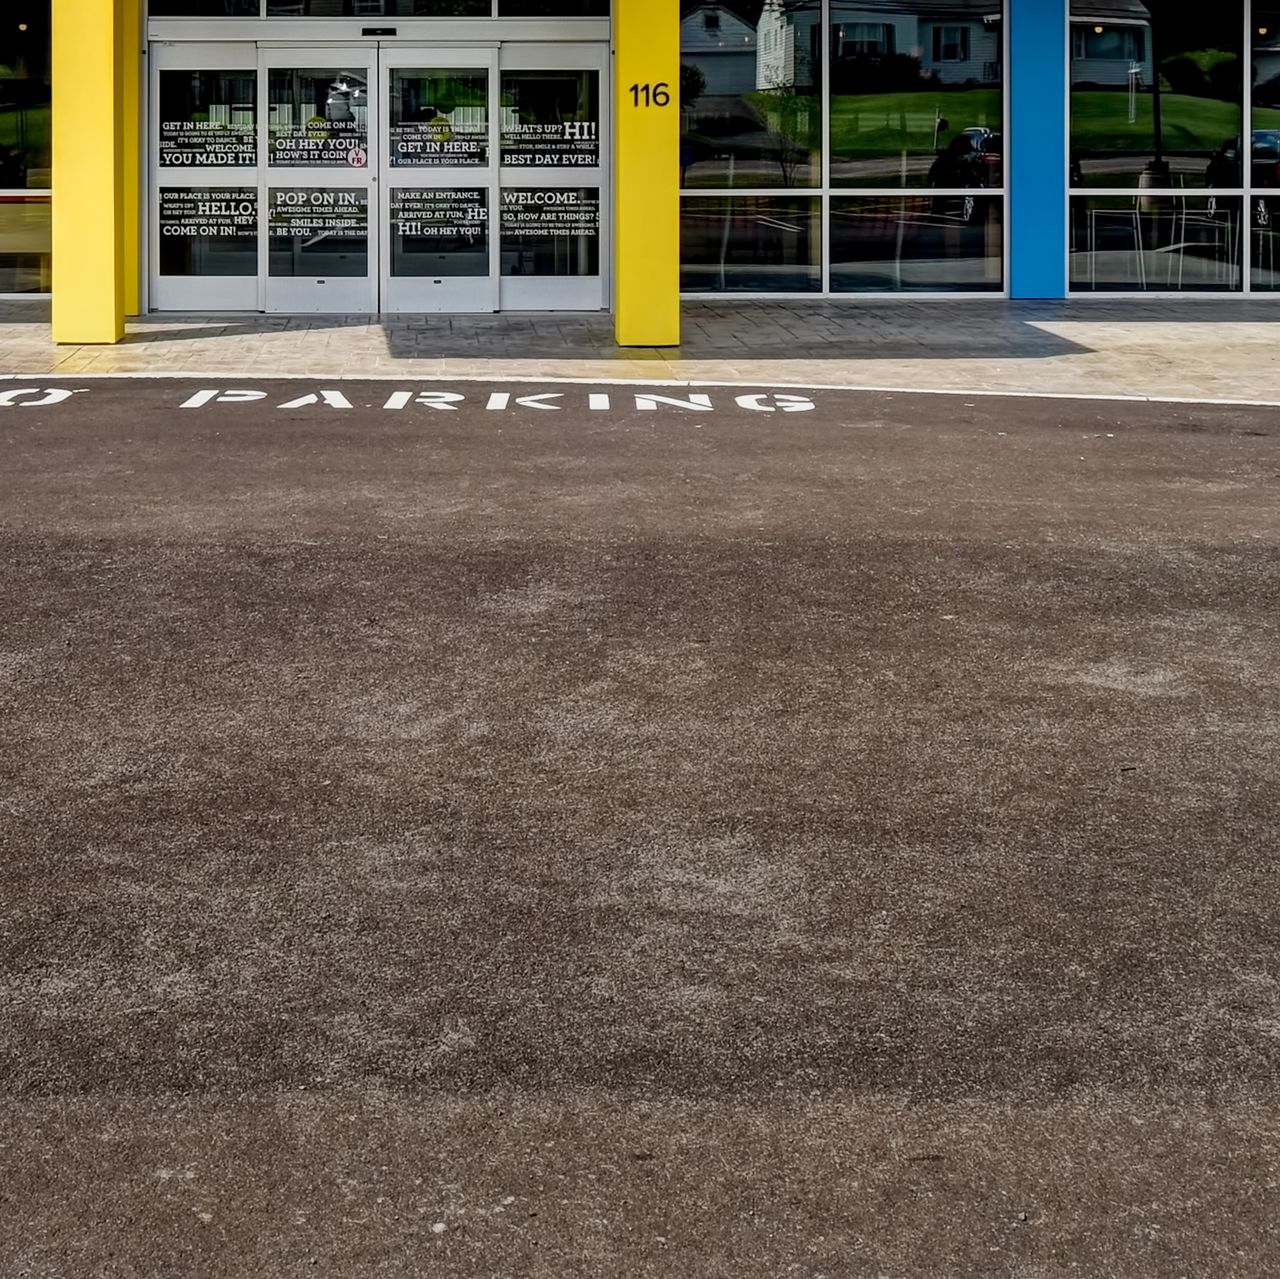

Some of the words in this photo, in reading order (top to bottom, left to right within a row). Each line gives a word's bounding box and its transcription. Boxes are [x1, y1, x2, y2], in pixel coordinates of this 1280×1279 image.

[630, 82, 670, 107] 116
[162, 122, 181, 130] GET
[182, 122, 194, 130] IN
[504, 124, 542, 132] WHAT'S
[544, 124, 562, 132] UP?
[564, 122, 596, 140] HI!
[206, 144, 256, 152] WELCOME.
[276, 139, 297, 149] OH
[298, 139, 326, 149] HEY
[328, 139, 358, 149] YOU!
[398, 142, 424, 152] GET
[426, 142, 440, 152] IN
[444, 142, 480, 152] HERE.
[163, 153, 192, 164] YOU
[195, 153, 235, 164] MADE
[238, 153, 256, 164] IT!
[276, 151, 308, 159] HOW'S
[310, 151, 320, 159] IT
[504, 155, 532, 164] BEST
[535, 155, 560, 164] DAY
[562, 155, 596, 164] EVER!
[276, 193, 307, 204] POP
[310, 193, 335, 204] ON
[338, 193, 359, 204] IN.
[503, 193, 580, 204] WELCOME.
[198, 202, 256, 215] HELLO.
[163, 226, 198, 235] COME
[200, 226, 218, 235] ON
[220, 226, 236, 235] IN!
[398, 222, 421, 234] HI!
[179, 389, 816, 411] PARKING
